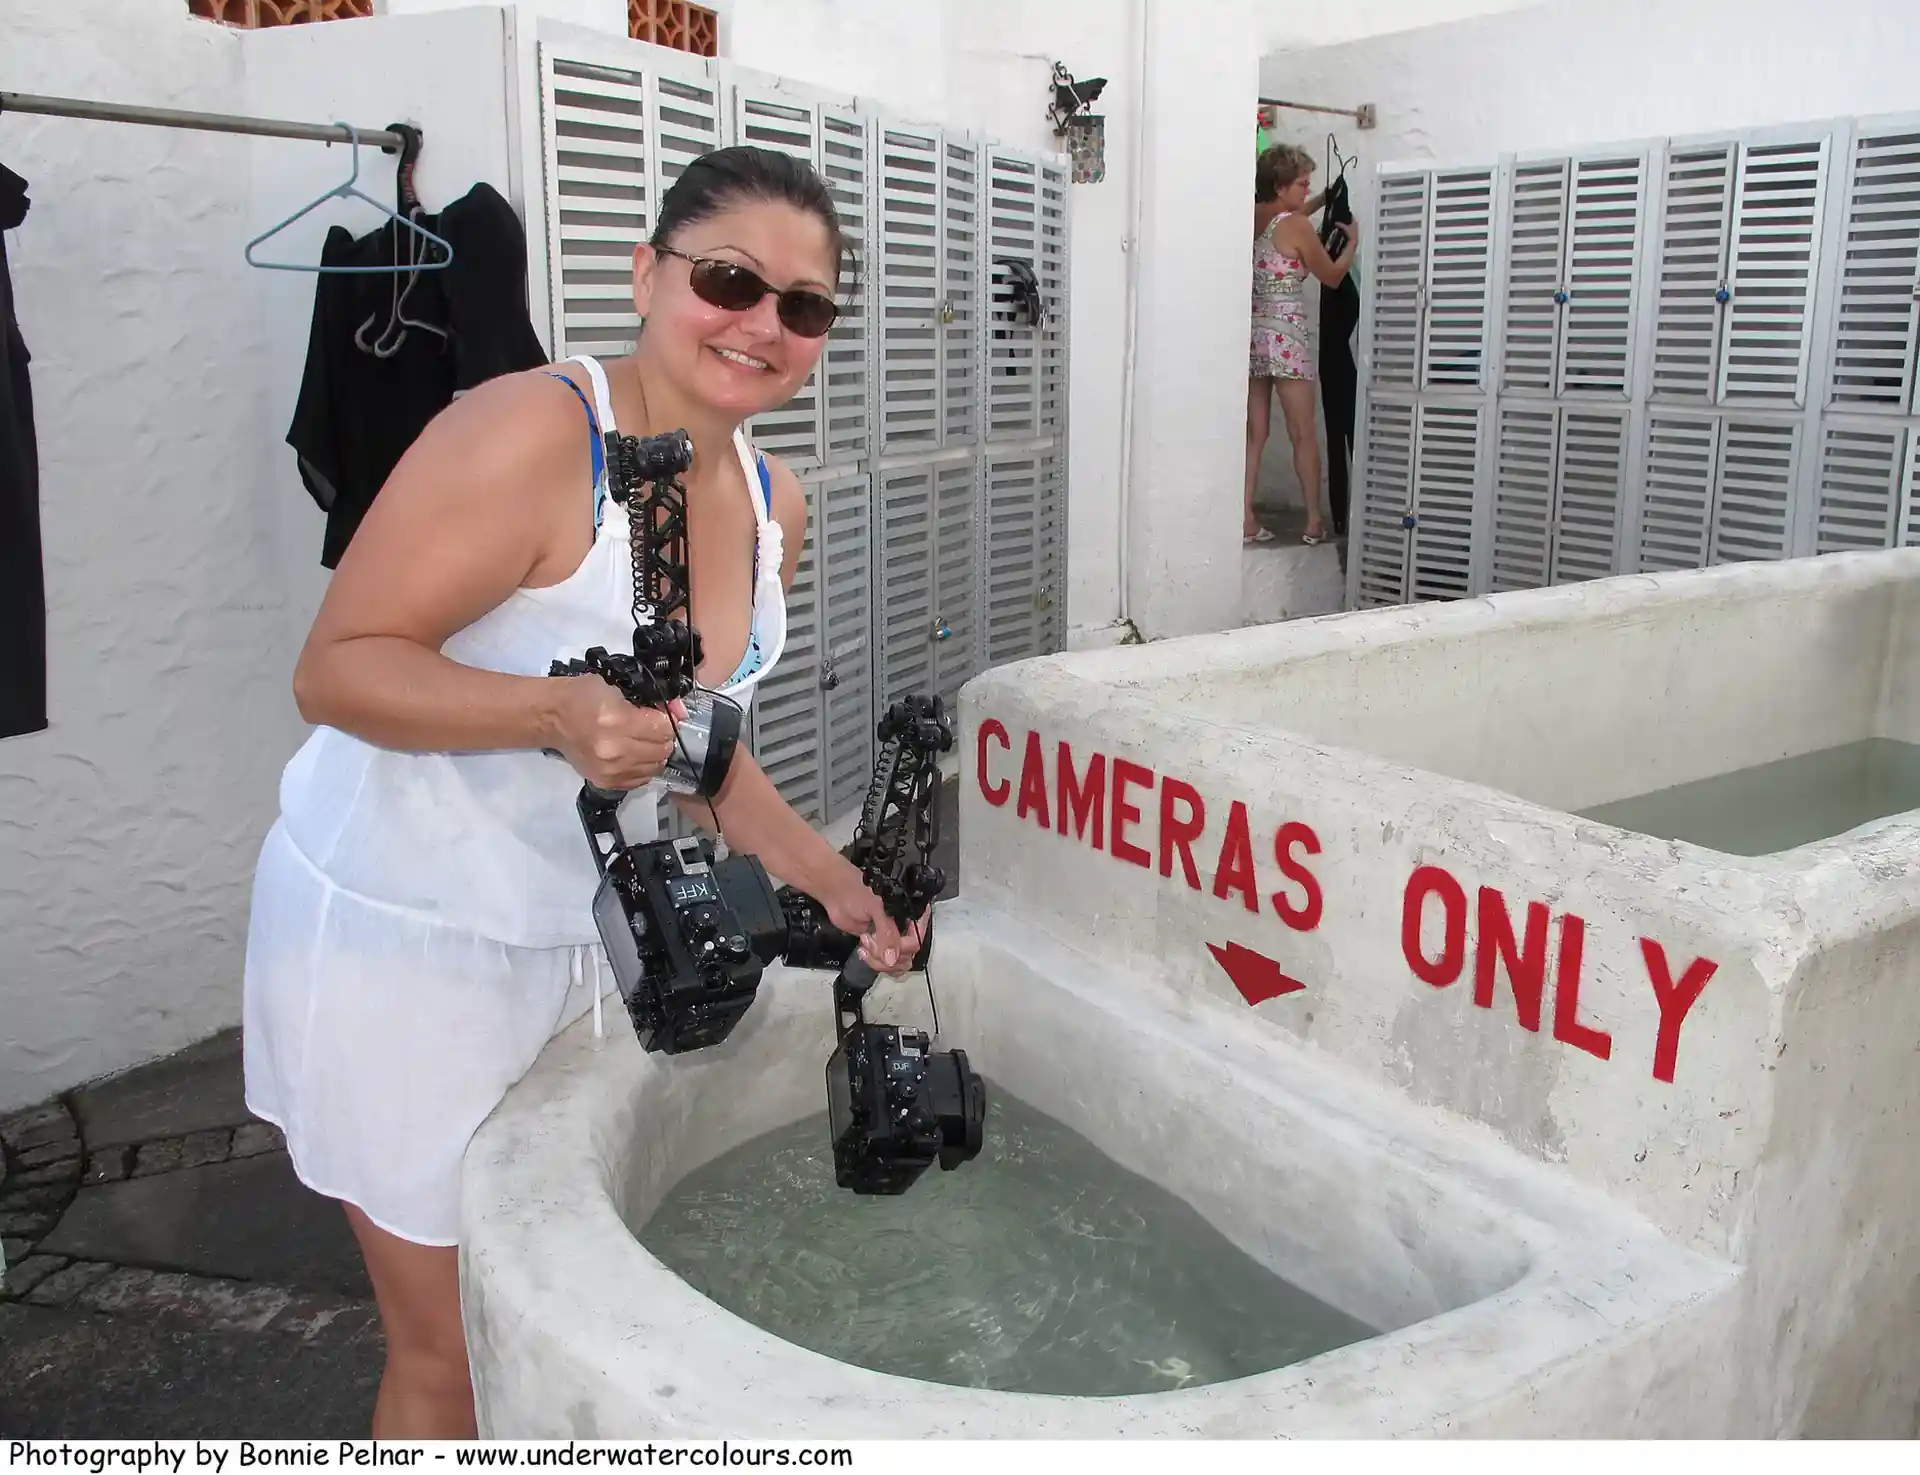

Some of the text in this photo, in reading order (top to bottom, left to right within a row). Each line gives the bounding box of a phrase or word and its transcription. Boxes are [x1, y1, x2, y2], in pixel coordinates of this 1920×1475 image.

[677, 883, 708, 900] KFF
[978, 718, 1718, 1084] CAMERAS ONLY
[893, 1062, 909, 1071] DJF
